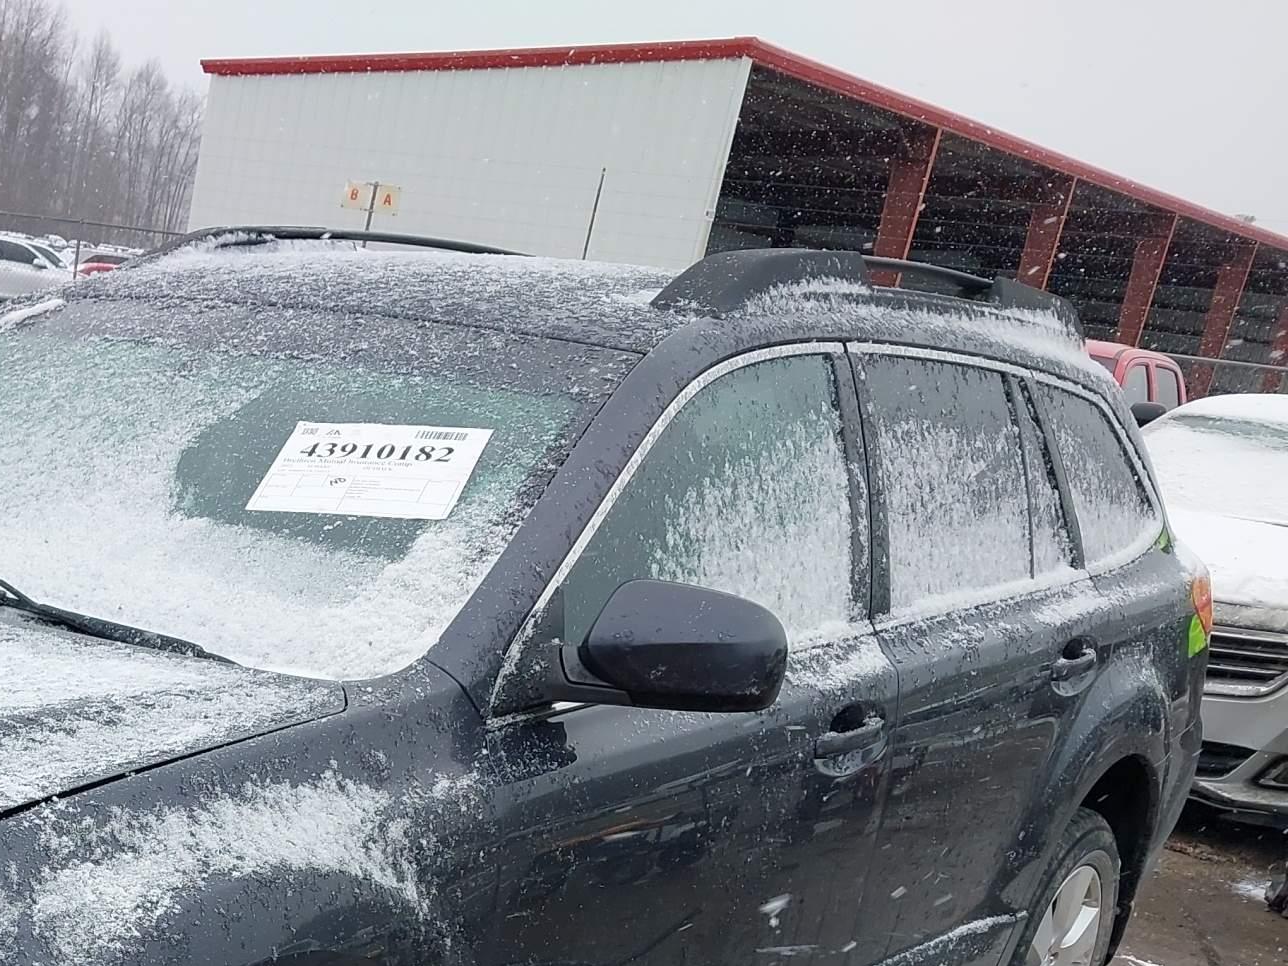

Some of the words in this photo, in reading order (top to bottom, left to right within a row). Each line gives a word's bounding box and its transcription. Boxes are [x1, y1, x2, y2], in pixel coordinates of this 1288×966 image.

[350, 188, 359, 200] B
[383, 193, 392, 206] A
[300, 442, 455, 462] 43910182
